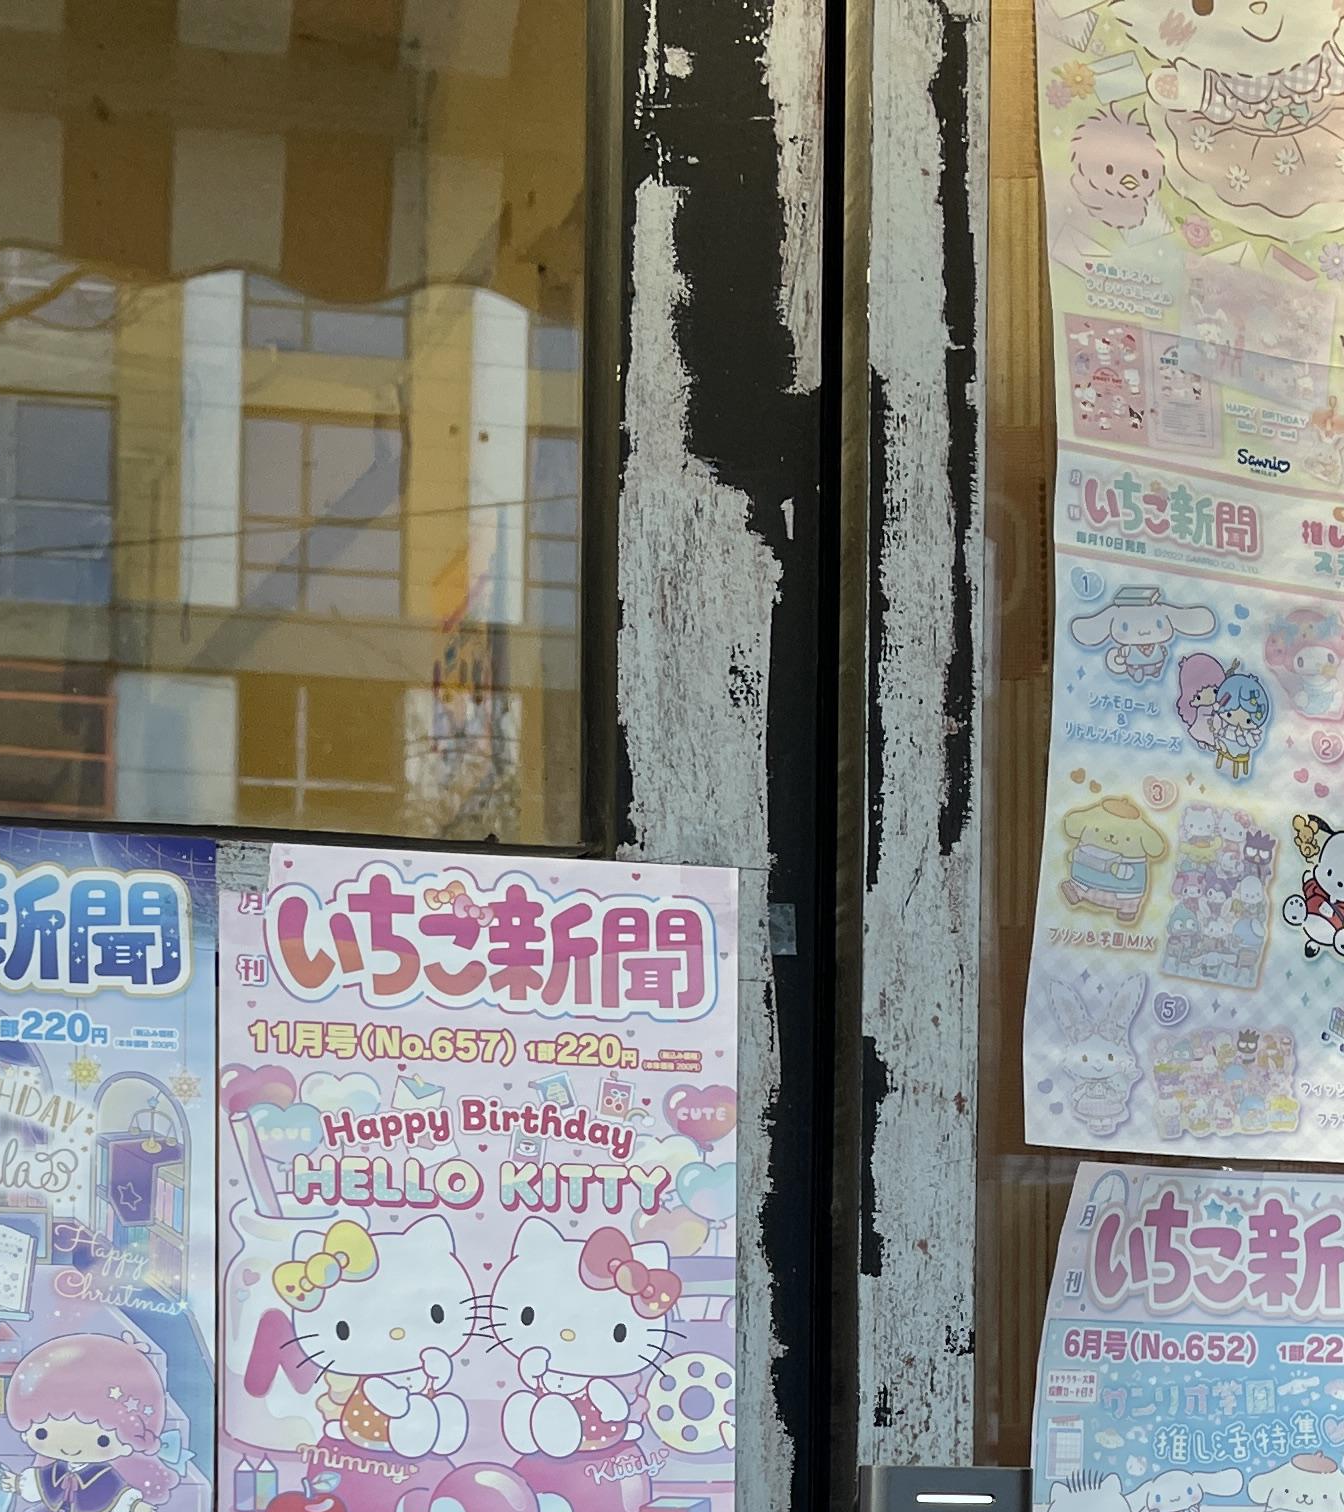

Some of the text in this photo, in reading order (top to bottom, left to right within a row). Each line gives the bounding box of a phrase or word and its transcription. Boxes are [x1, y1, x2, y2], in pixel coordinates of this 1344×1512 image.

[1237, 449, 1290, 473] Sanrio
[1084, 470, 1258, 555] いちご新聞
[1076, 531, 1147, 555] 毎月10日発売
[1089, 692, 1159, 716] シナモロール
[1065, 721, 1183, 754] リトルツインスターズ
[1320, 738, 1332, 756] 2
[1151, 783, 1163, 802] 3
[277, 873, 704, 1009] いちご新聞
[1161, 1001, 1175, 1019] 5
[248, 1019, 517, 1066] 11月号(No.657)
[525, 1032, 640, 1069] 1部220円
[323, 1098, 637, 1161] Happy Birthday
[677, 1105, 727, 1123] CUTE
[257, 1125, 312, 1143] LOVE
[293, 1153, 672, 1216] HELLO KITTY
[54, 1223, 152, 1280] Happy
[54, 1269, 181, 1316] Christmas
[1063, 1330, 1258, 1365] 6月号(No.652)
[585, 1452, 664, 1486] Kitty
